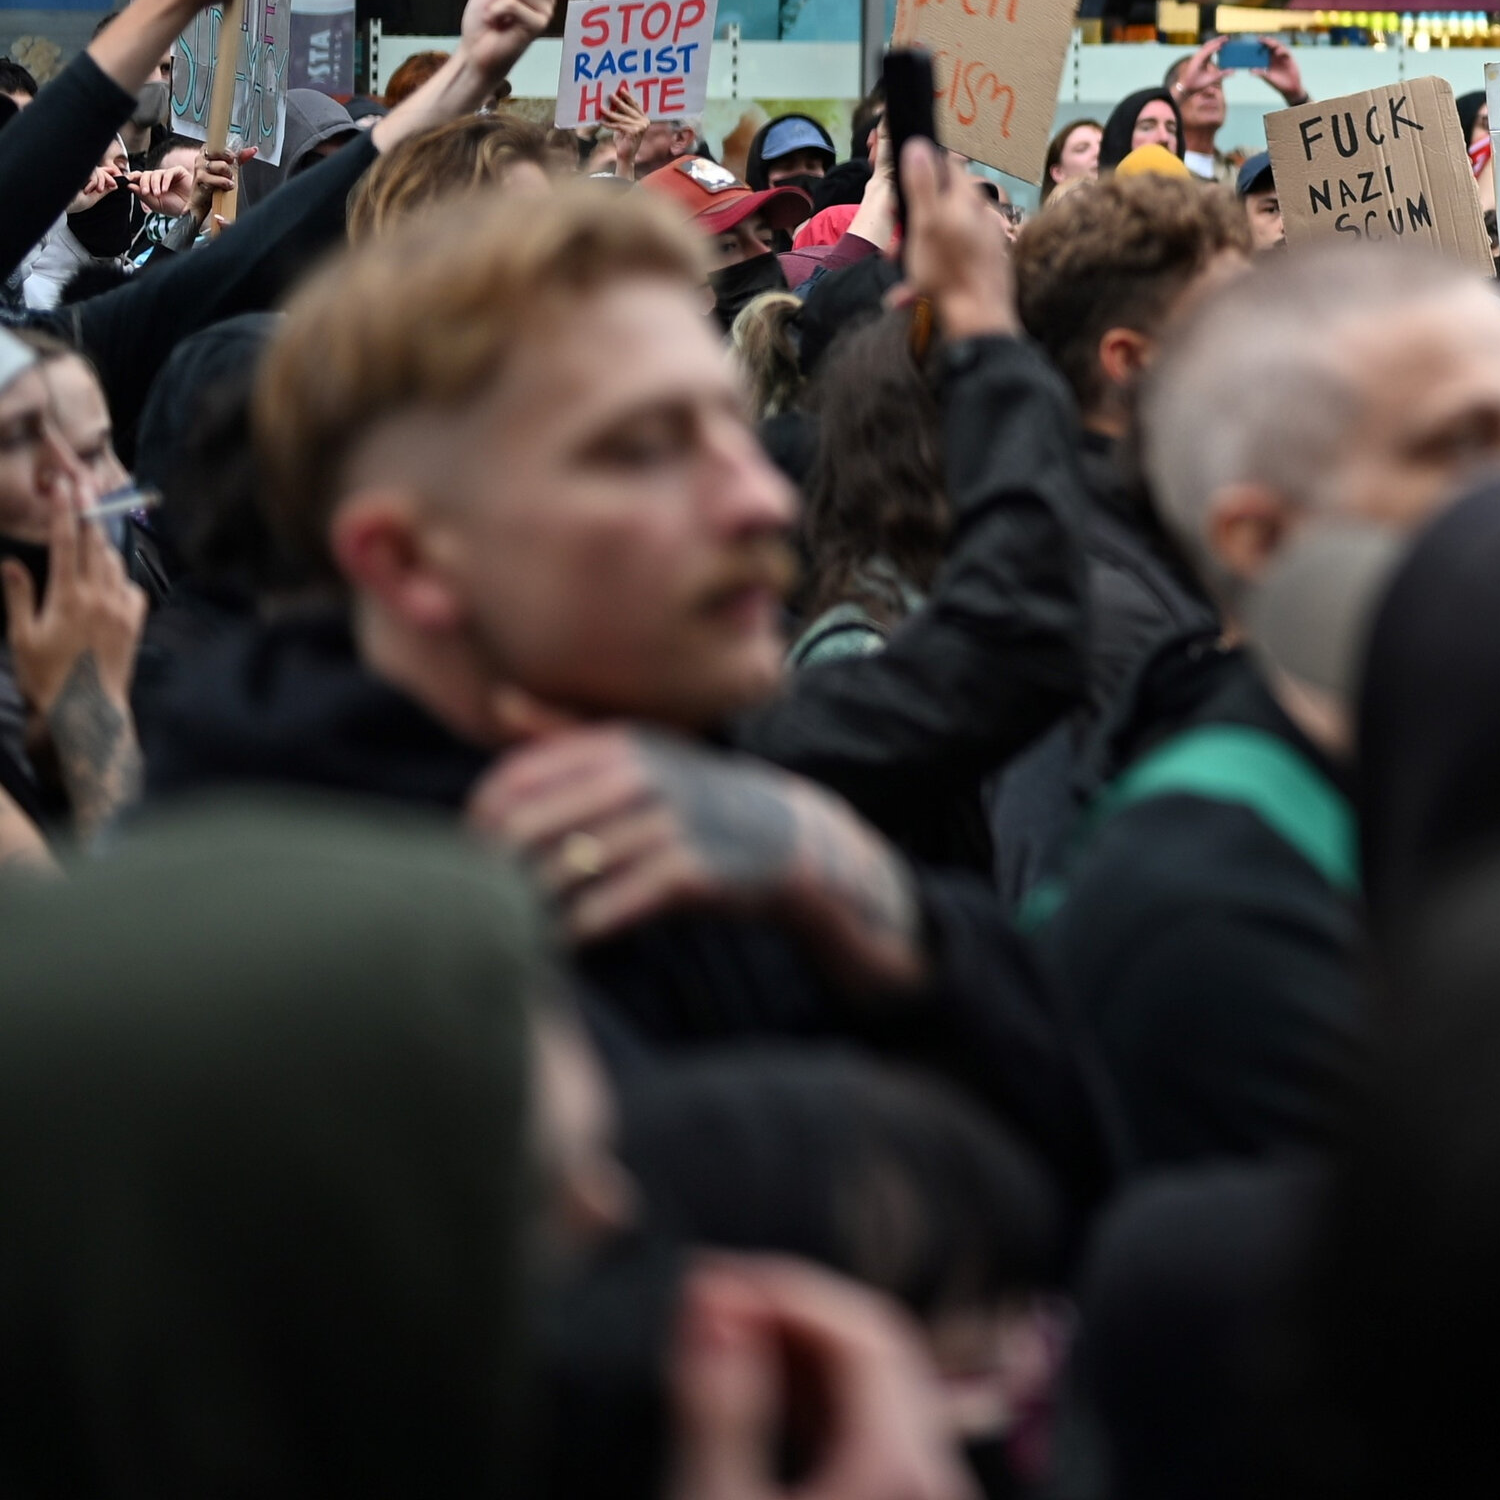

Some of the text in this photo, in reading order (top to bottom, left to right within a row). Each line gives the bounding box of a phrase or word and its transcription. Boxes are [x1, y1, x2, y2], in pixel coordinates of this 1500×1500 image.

[573, 42, 699, 83] RACIST
[1298, 95, 1425, 161] FUCK
[1308, 165, 1395, 215] NAZI
[1334, 190, 1433, 243] SCUM
